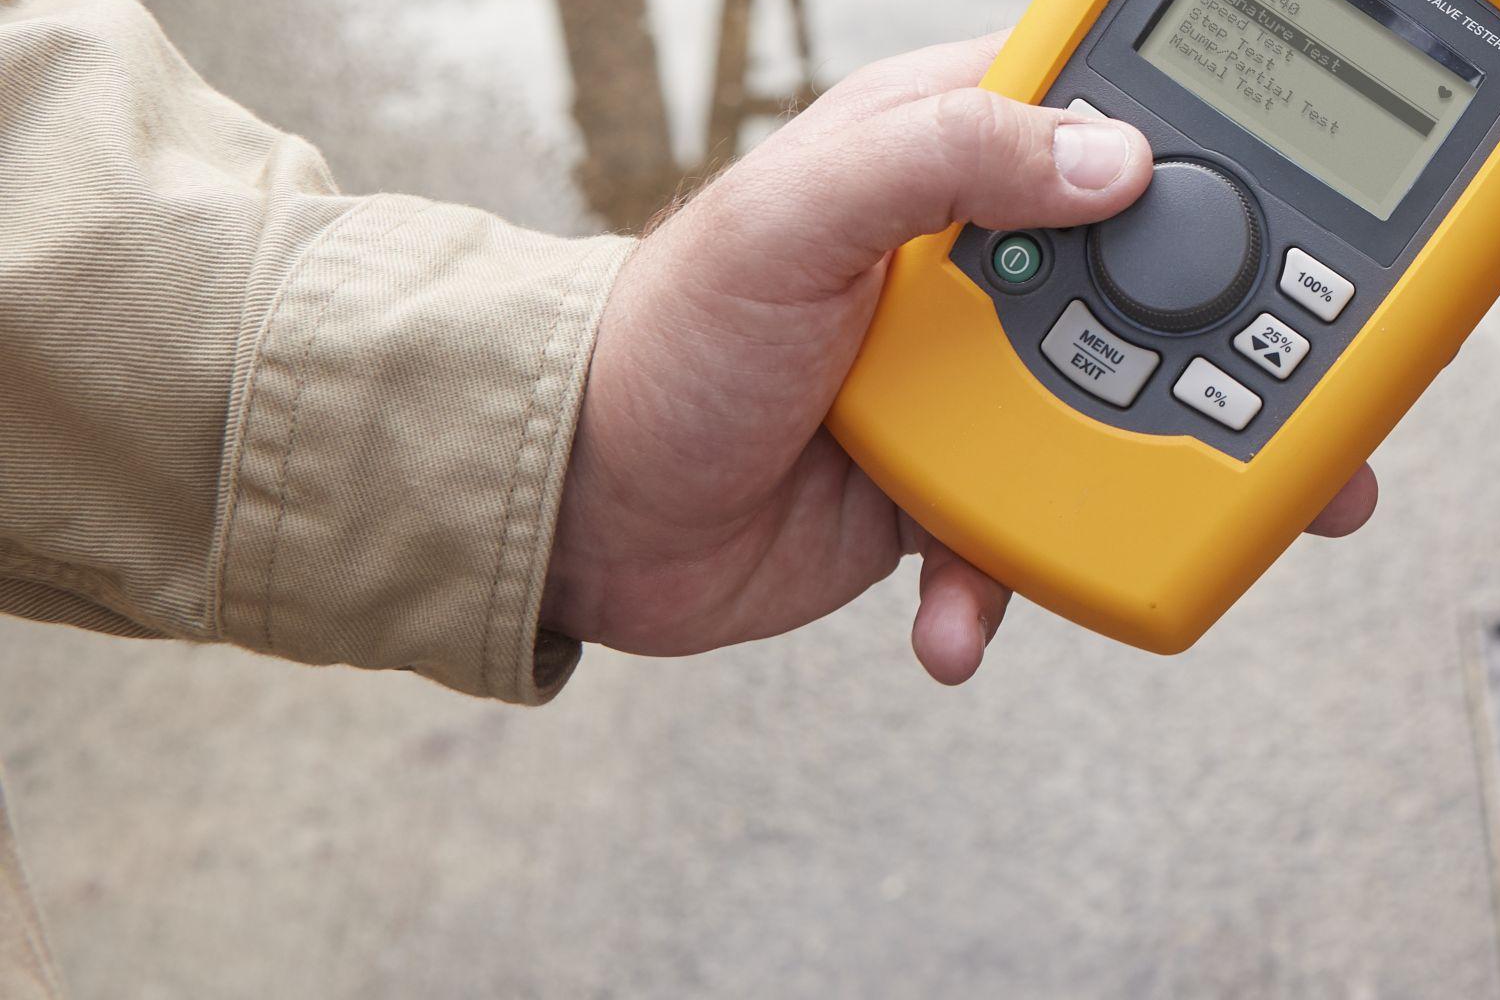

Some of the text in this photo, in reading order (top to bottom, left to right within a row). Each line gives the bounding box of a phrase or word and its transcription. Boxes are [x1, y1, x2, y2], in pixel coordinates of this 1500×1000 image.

[1189, 7, 1276, 71] Step Test
[1256, 31, 1295, 63] Test
[1169, 33, 1275, 111] Manual Test
[1302, 39, 1342, 73] Test
[1179, 20, 1340, 135] Bump/Partial Test
[1297, 271, 1333, 303] 100%
[1079, 328, 1125, 366] MENU
[1261, 326, 1293, 354] 25%
[1070, 352, 1106, 382] EXIT
[1204, 385, 1227, 409] 0%
